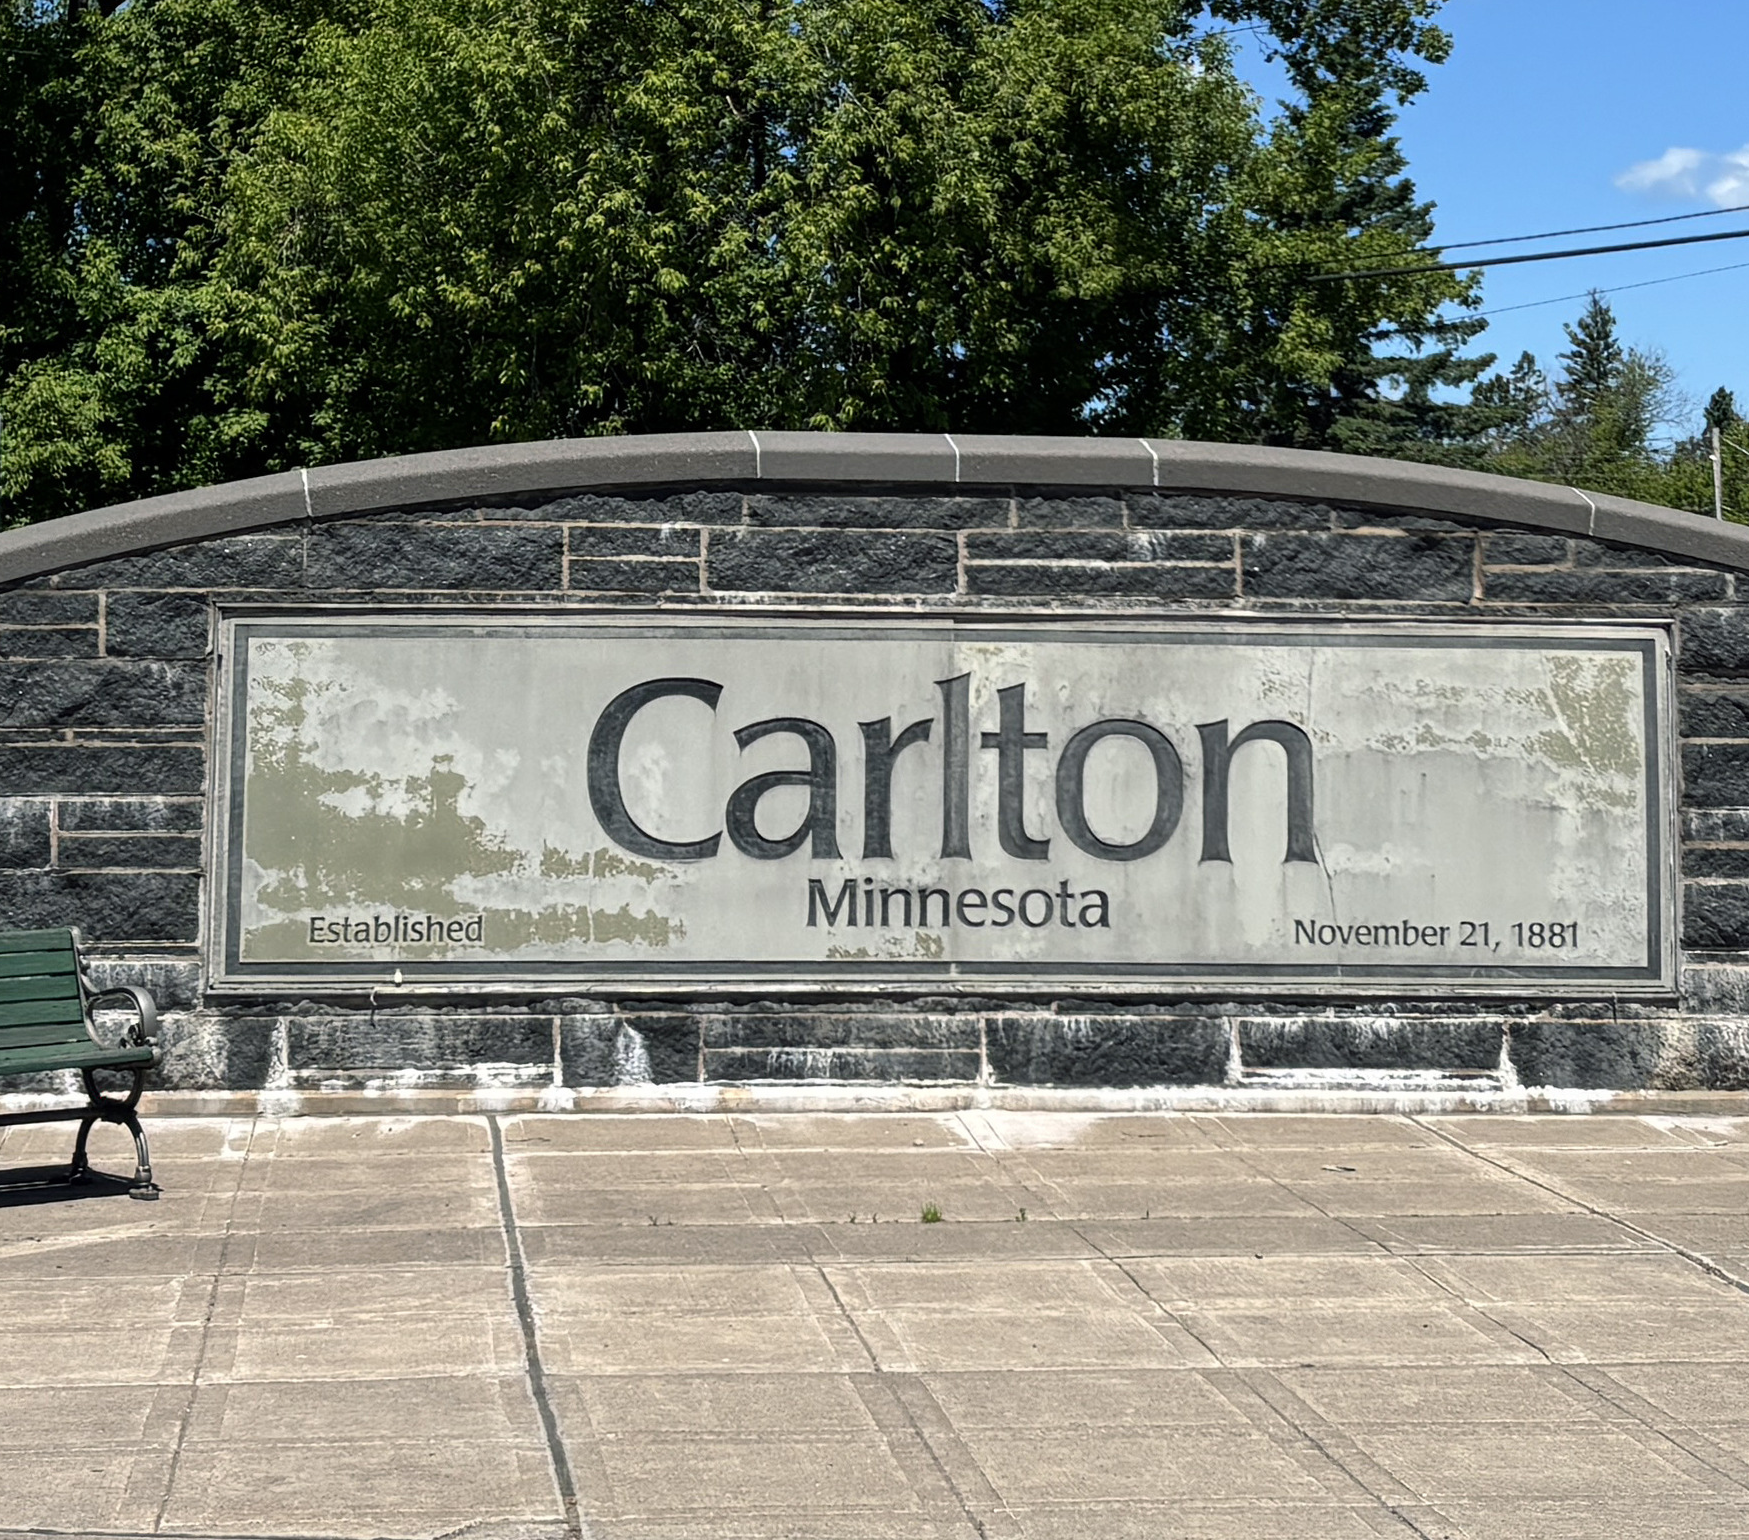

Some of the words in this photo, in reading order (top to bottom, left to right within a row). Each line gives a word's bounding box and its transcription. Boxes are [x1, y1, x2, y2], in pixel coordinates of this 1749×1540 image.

[586, 671, 1320, 865] Carlton
[805, 877, 1111, 930] Minnesota
[308, 914, 484, 944] Established
[1294, 918, 1450, 947] November
[1459, 920, 1500, 953] 21,
[1511, 920, 1579, 948] 1881
